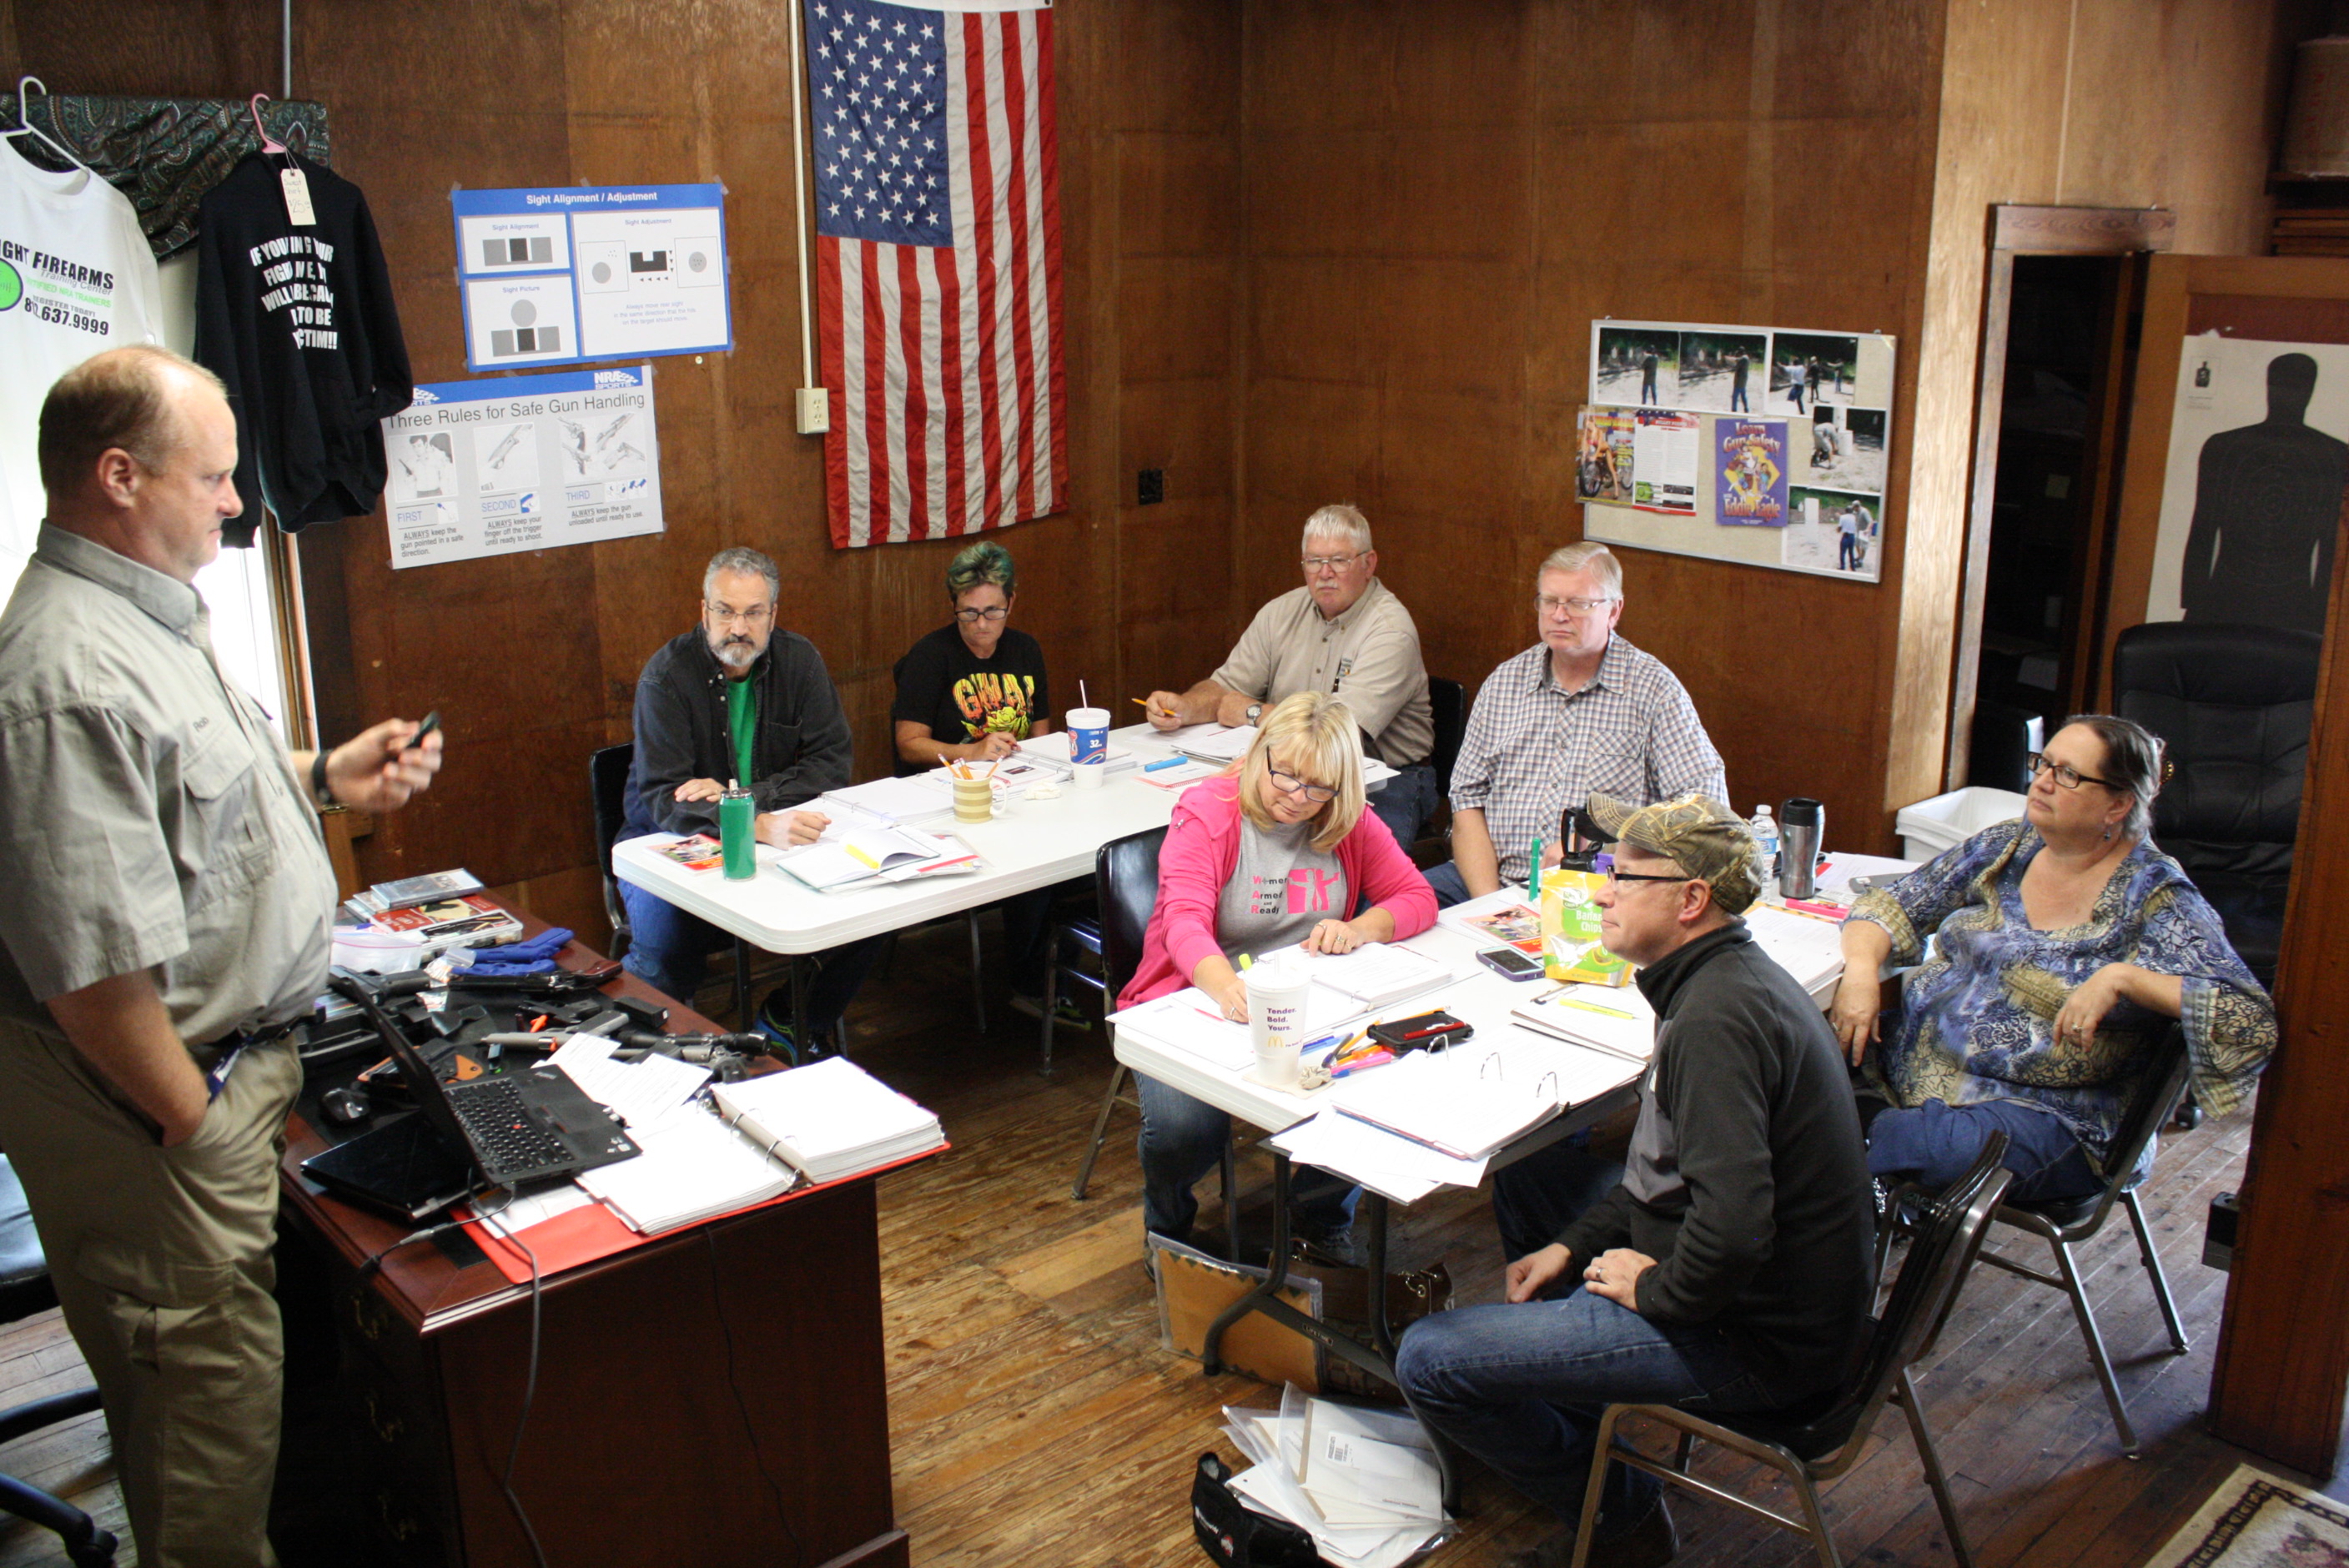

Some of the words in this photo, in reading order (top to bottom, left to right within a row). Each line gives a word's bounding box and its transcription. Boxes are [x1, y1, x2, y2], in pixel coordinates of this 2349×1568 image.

[526, 194, 551, 206] Sight
[553, 193, 600, 205] Alignment
[607, 192, 657, 203] Adjustment
[510, 223, 540, 231] Alignment
[641, 218, 672, 226] Adjustment
[250, 246, 262, 266] IF
[33, 251, 114, 289] FIREARMS
[41, 269, 78, 288] Training
[80, 280, 113, 296] Center
[75, 292, 112, 309] TRAINERS
[261, 285, 293, 313] WILL
[297, 306, 313, 324] TO
[315, 308, 331, 326] BE
[293, 329, 338, 349] VCTIM!!
[438, 409, 481, 425] Rules
[486, 405, 506, 420] for
[511, 401, 543, 417] Safe
[549, 399, 579, 414] Gun
[585, 394, 645, 410] Handling
[1736, 422, 1765, 435] Learn
[1723, 436, 1747, 453] Gun
[1748, 433, 1781, 456] Safety
[566, 490, 590, 500] THIRD
[481, 500, 516, 512] SECOND
[1755, 498, 1781, 521] Eagle
[397, 510, 422, 522] FIRST
[571, 508, 595, 518] ALWAYS
[488, 519, 512, 529] ALWAYS
[569, 517, 594, 525] unloaded
[404, 530, 430, 540] ALWAYS
[523, 525, 542, 533] trigger
[400, 542, 412, 550] gun
[415, 538, 437, 548] pointed
[1250, 905, 1280, 914] Ready
[1581, 922, 1602, 932] Chips
